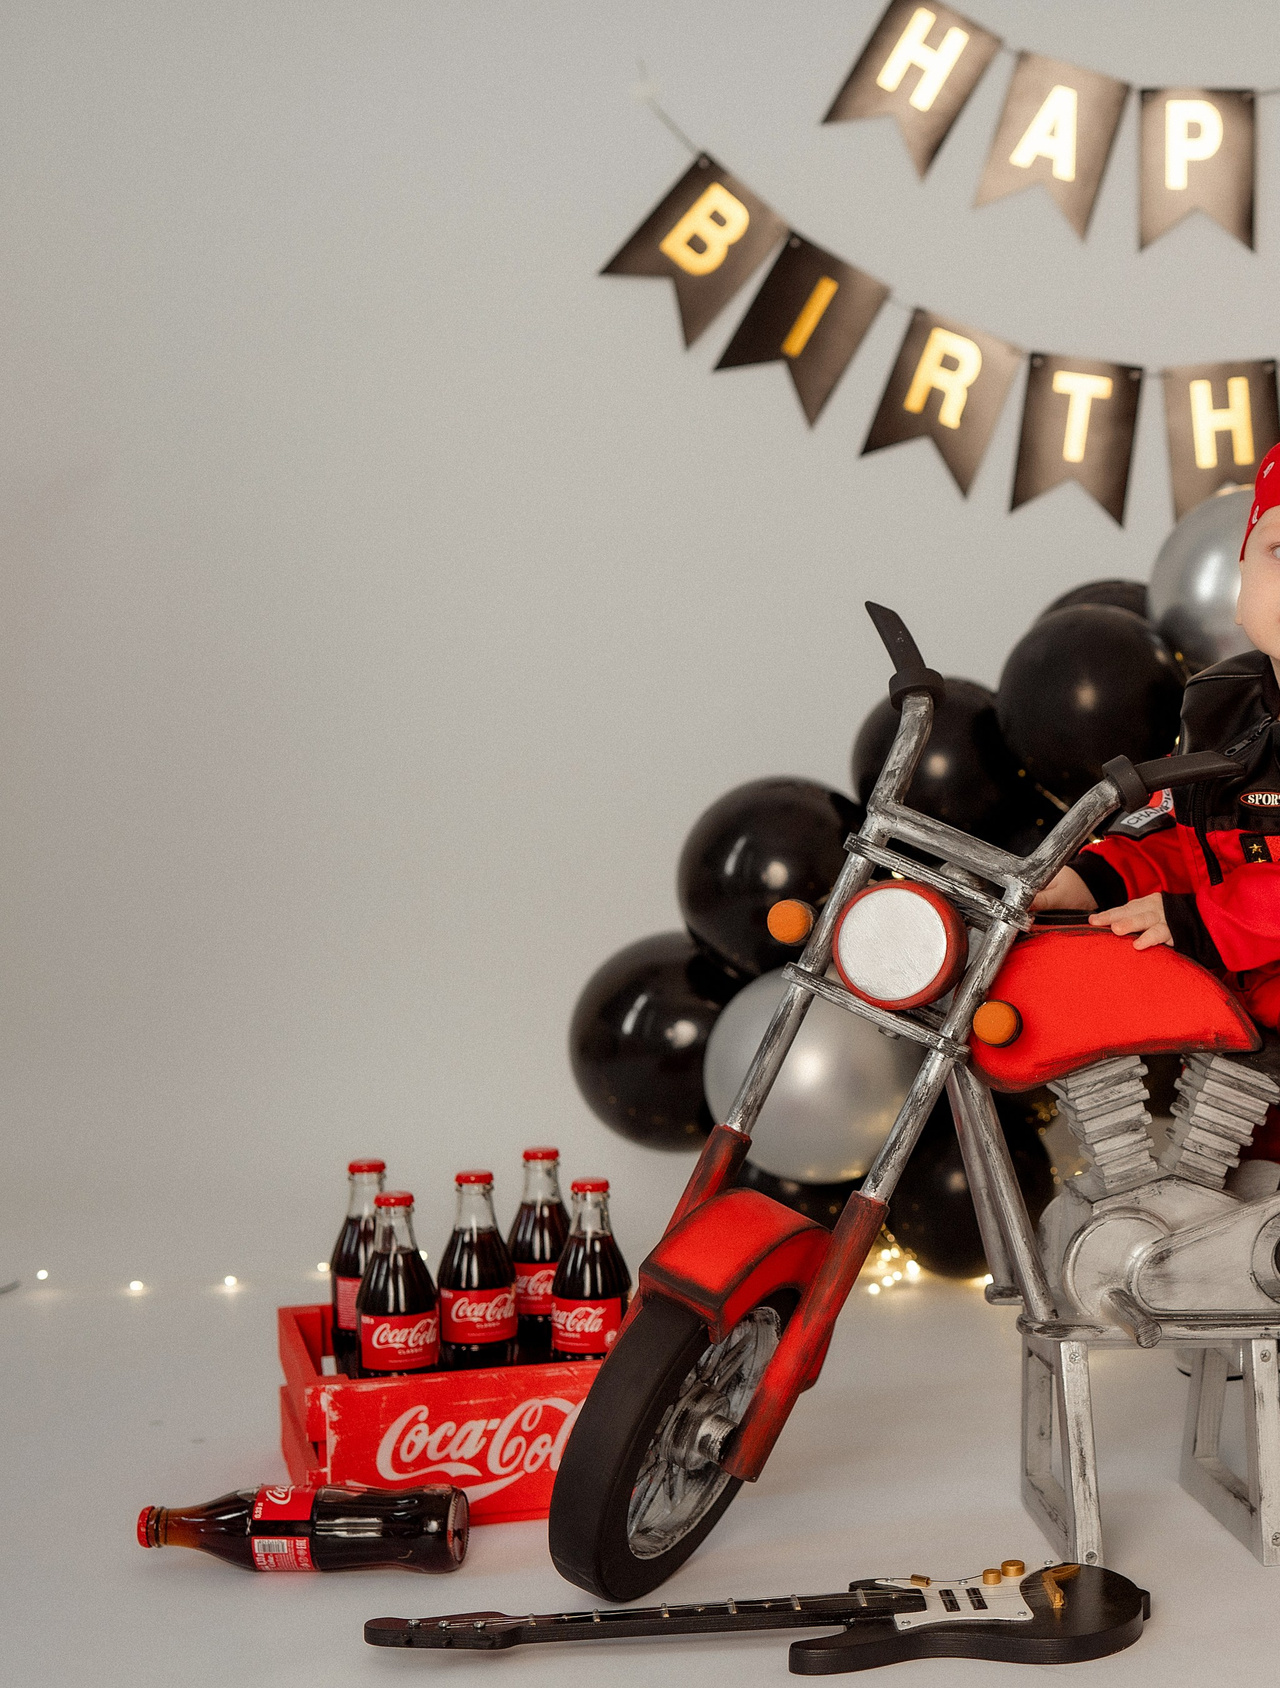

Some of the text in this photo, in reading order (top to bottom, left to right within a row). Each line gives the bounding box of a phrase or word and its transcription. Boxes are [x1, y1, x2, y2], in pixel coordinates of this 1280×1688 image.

[1127, 789, 1171, 825] CHAMPIO
[371, 1317, 438, 1349] Coca-Cola
[376, 1397, 586, 1481] Coca-Col
